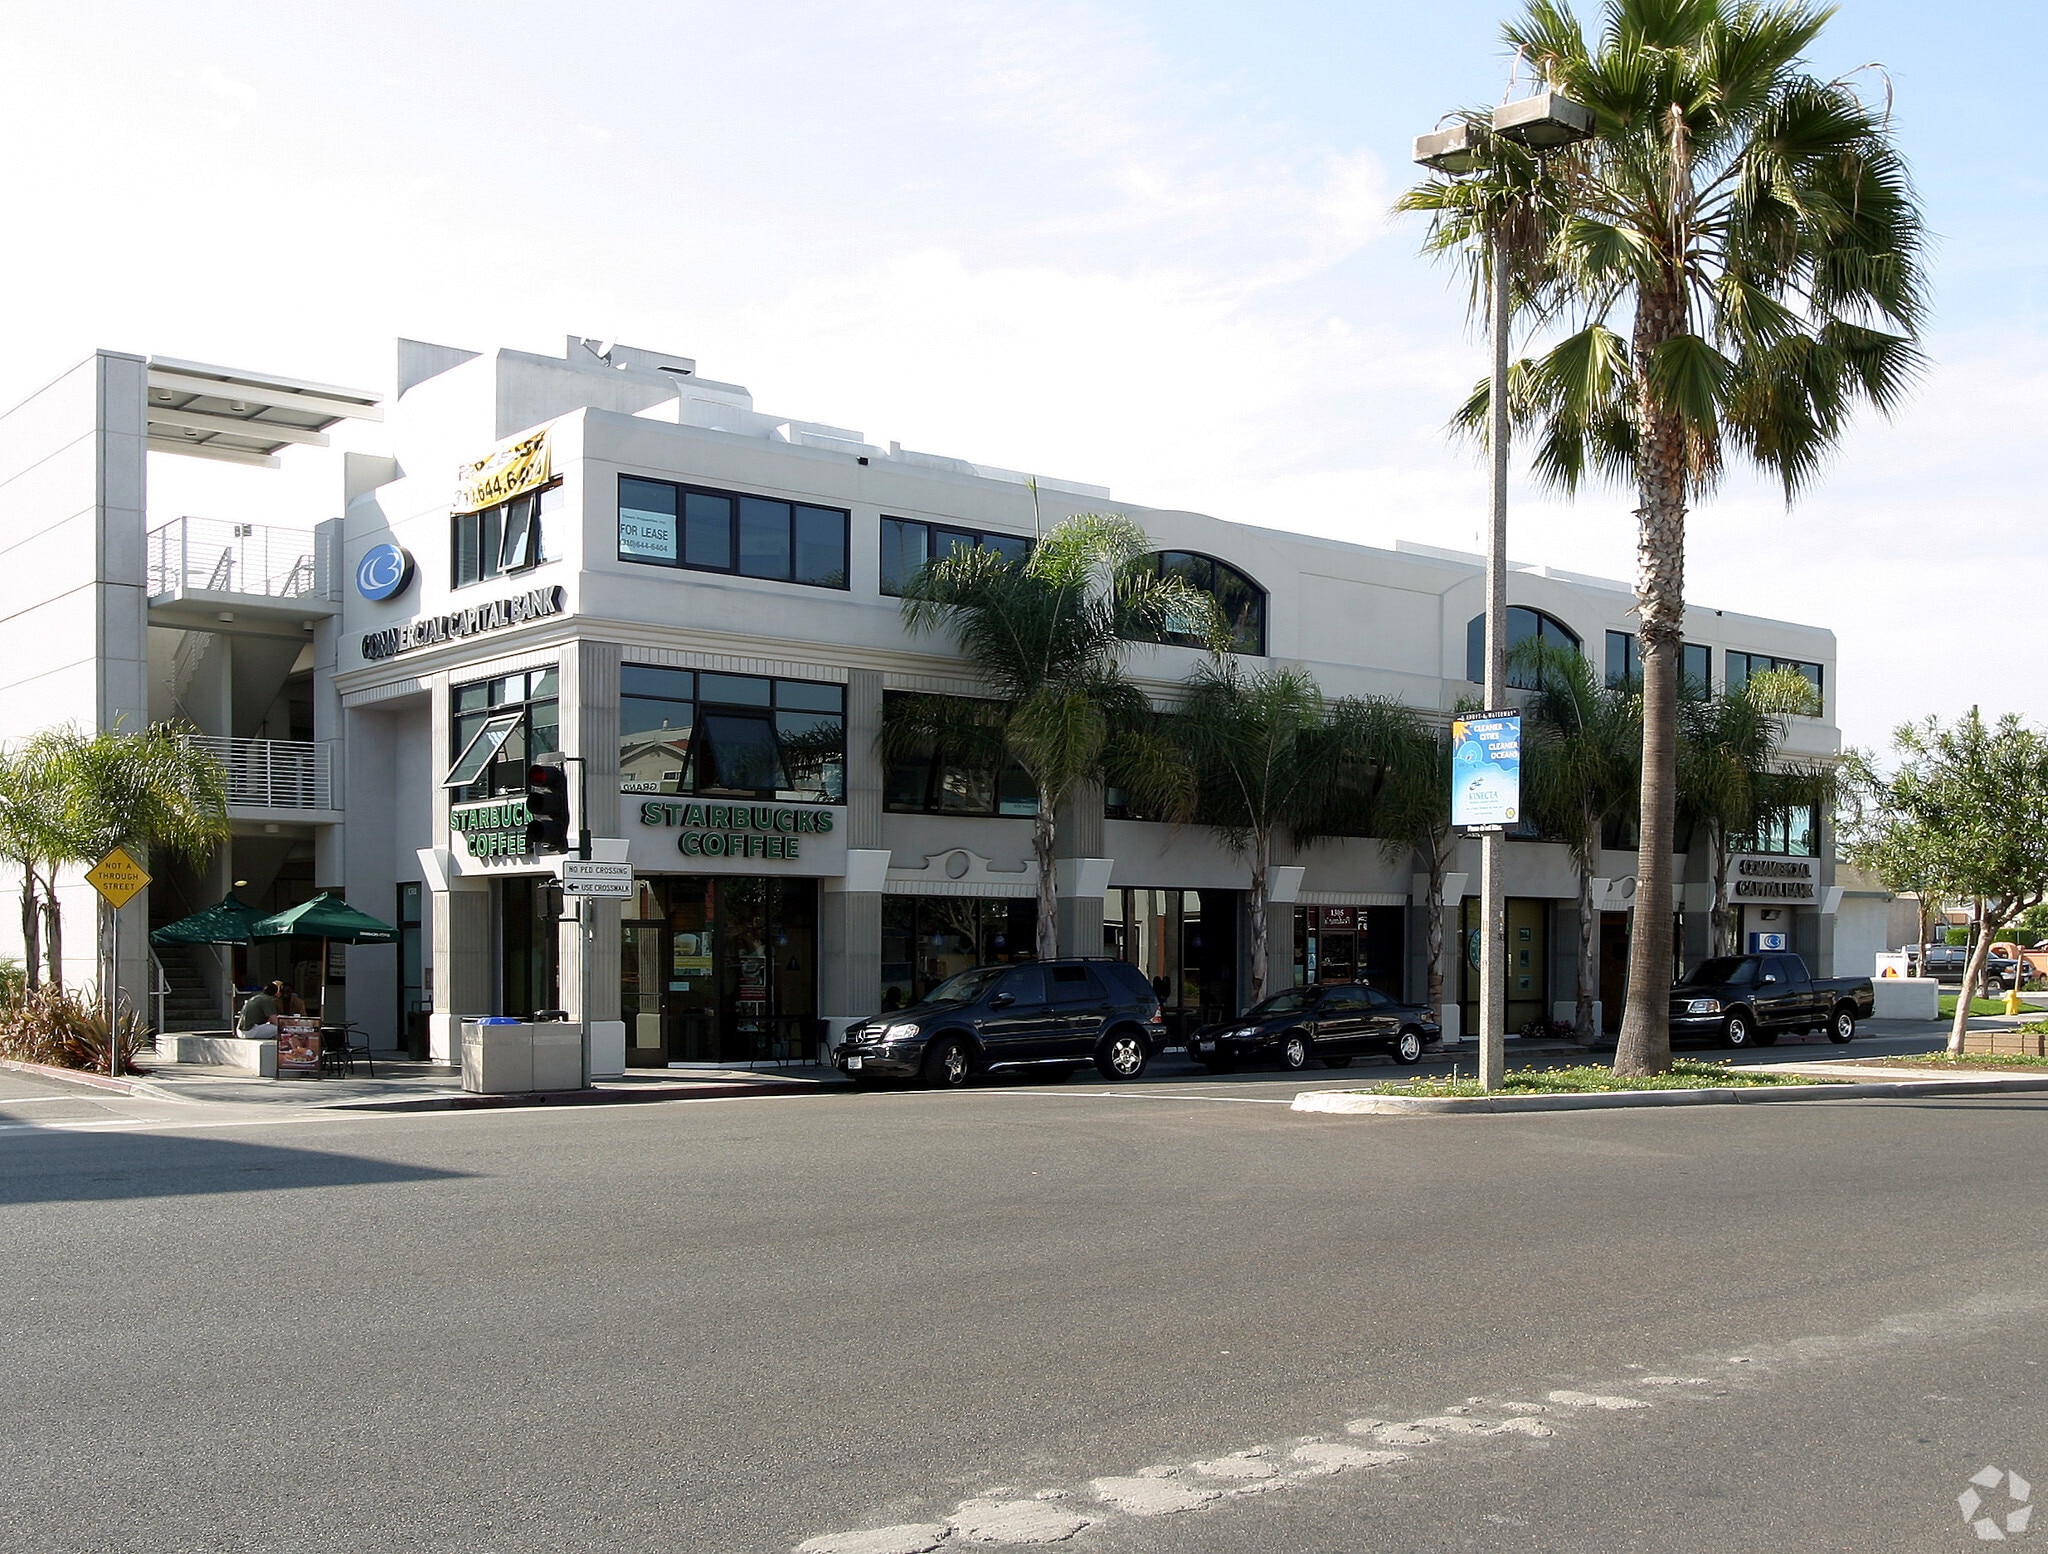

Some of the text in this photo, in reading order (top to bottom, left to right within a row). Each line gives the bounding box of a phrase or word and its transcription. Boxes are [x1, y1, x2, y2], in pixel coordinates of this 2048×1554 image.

[620, 523, 669, 541] FOR LEASE
[361, 585, 562, 660] COMMERCIAL CAPITAL BANK
[1473, 723, 1503, 732] CLEANER
[1479, 732, 1499, 740] CITIES
[1488, 741, 1518, 750] CLEANER
[1491, 751, 1518, 759] OCEANS
[450, 802, 534, 832] STARBUCK
[640, 801, 834, 833] STARBUCKS
[467, 831, 527, 857] COFFEE
[678, 831, 800, 860] COFFEE
[105, 862, 122, 870] NOT
[581, 866, 593, 874] PED
[595, 867, 628, 875] CROSSING
[98, 872, 139, 880] THROUGH
[103, 882, 136, 890] STREET
[594, 884, 630, 892] CROSSWALK
[1735, 880, 1787, 897] CAPITAL
